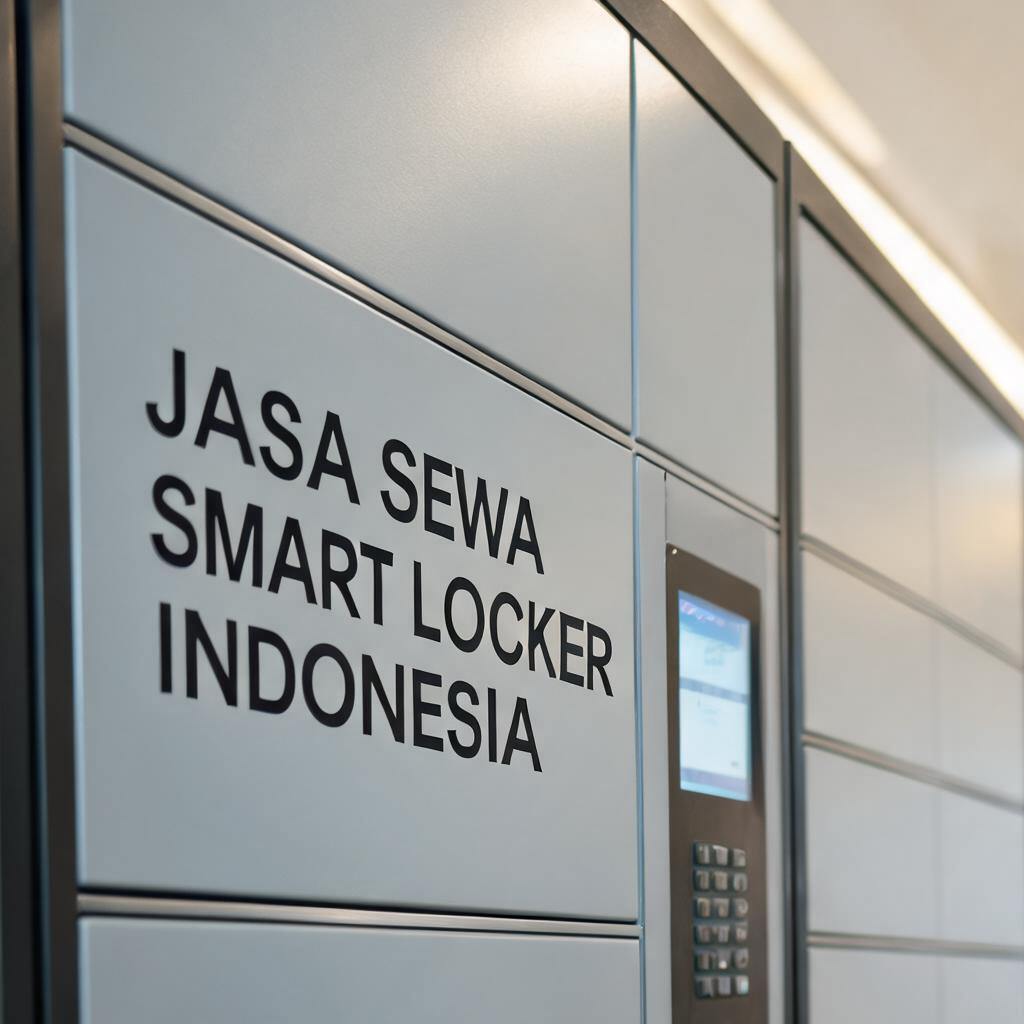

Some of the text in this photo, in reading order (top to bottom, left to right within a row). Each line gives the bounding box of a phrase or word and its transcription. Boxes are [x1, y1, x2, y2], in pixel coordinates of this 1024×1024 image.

[145, 348, 545, 575] JASA SEWA
[150, 474, 614, 697] SMART LOCKER
[159, 601, 543, 773] INDONESIA
